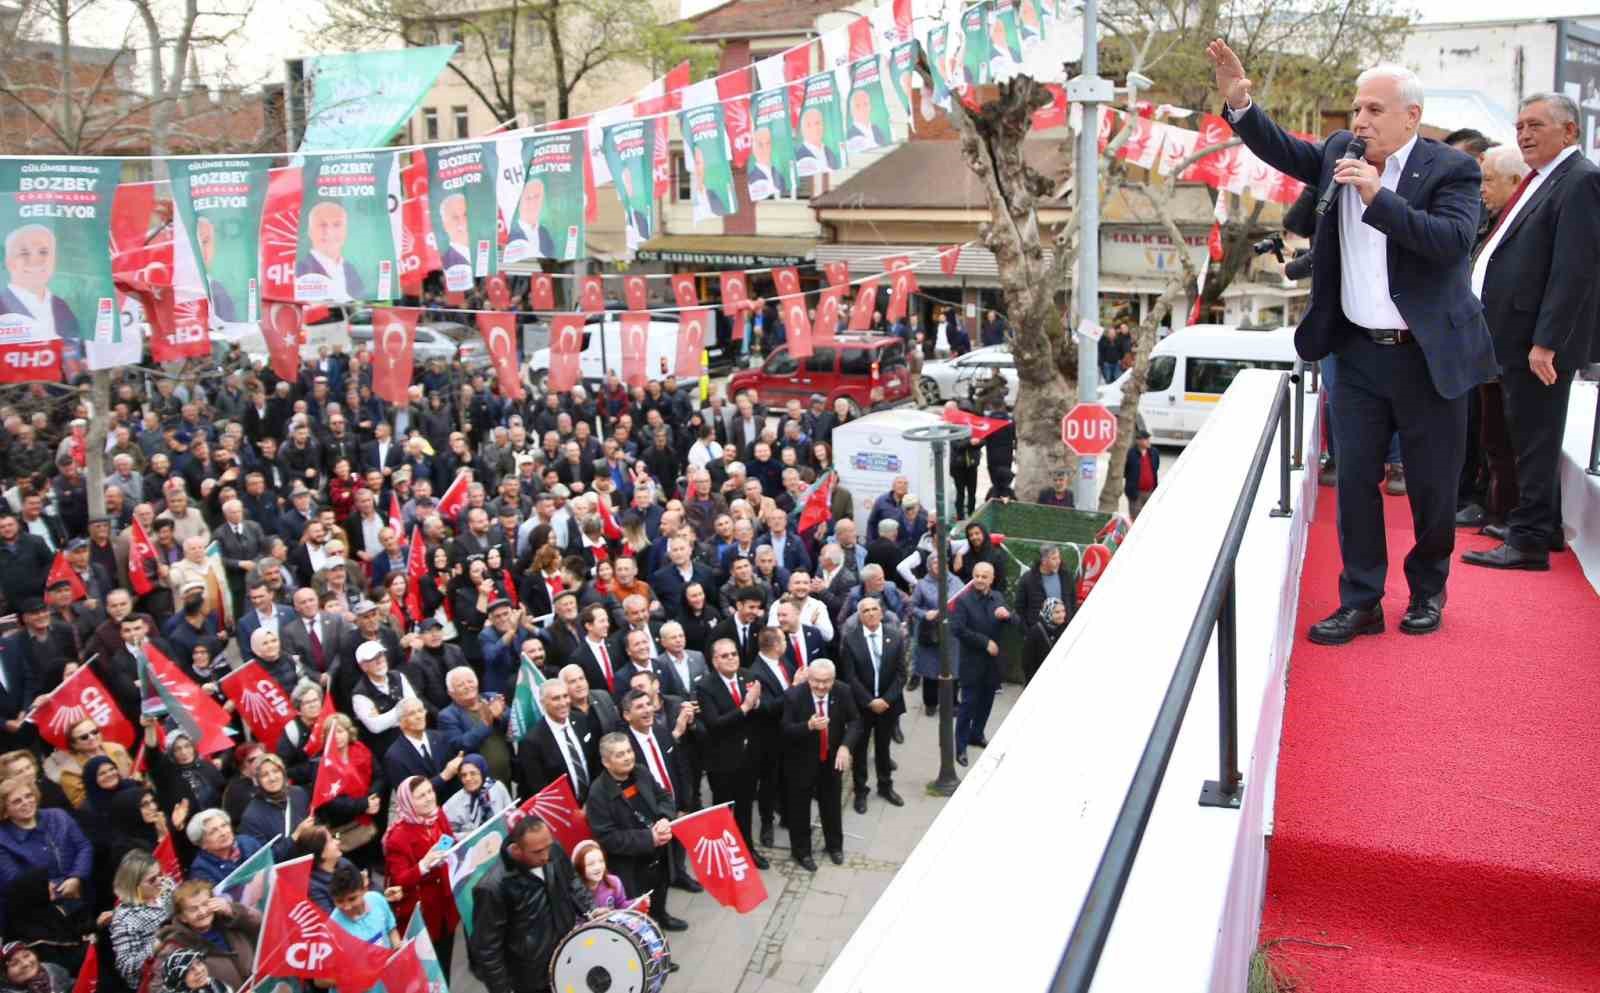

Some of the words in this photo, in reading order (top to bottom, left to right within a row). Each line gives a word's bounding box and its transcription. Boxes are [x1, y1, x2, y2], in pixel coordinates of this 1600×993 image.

[320, 162, 374, 176] BOZBEY
[20, 177, 97, 191] BOZBEY
[190, 171, 250, 187] BOZBEY
[1067, 418, 1112, 440] DUR
[80, 686, 112, 728] CHP
[256, 679, 289, 717] CHP
